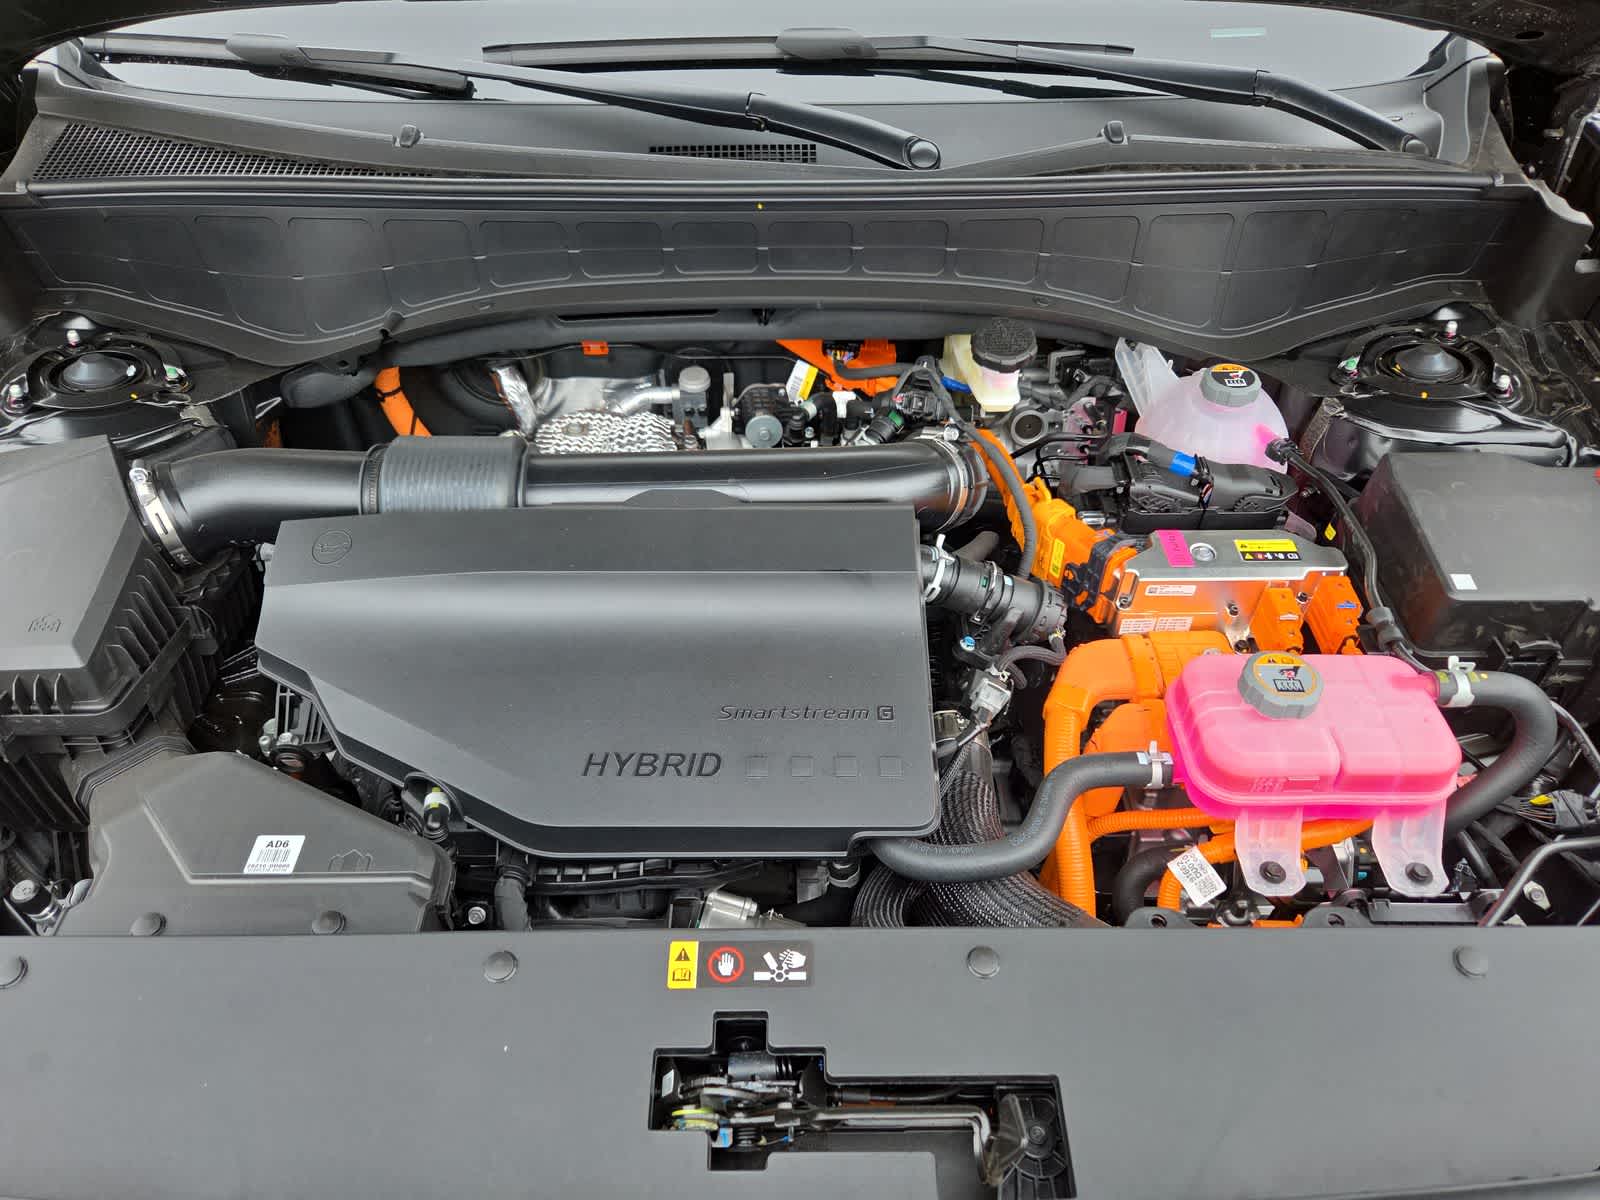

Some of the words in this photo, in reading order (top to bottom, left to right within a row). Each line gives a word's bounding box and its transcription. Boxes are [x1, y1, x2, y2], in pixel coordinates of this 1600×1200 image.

[717, 704, 870, 721] Smartstream
[877, 705, 895, 721] G
[581, 751, 722, 777] HYBRID
[265, 839, 290, 848] AD6
